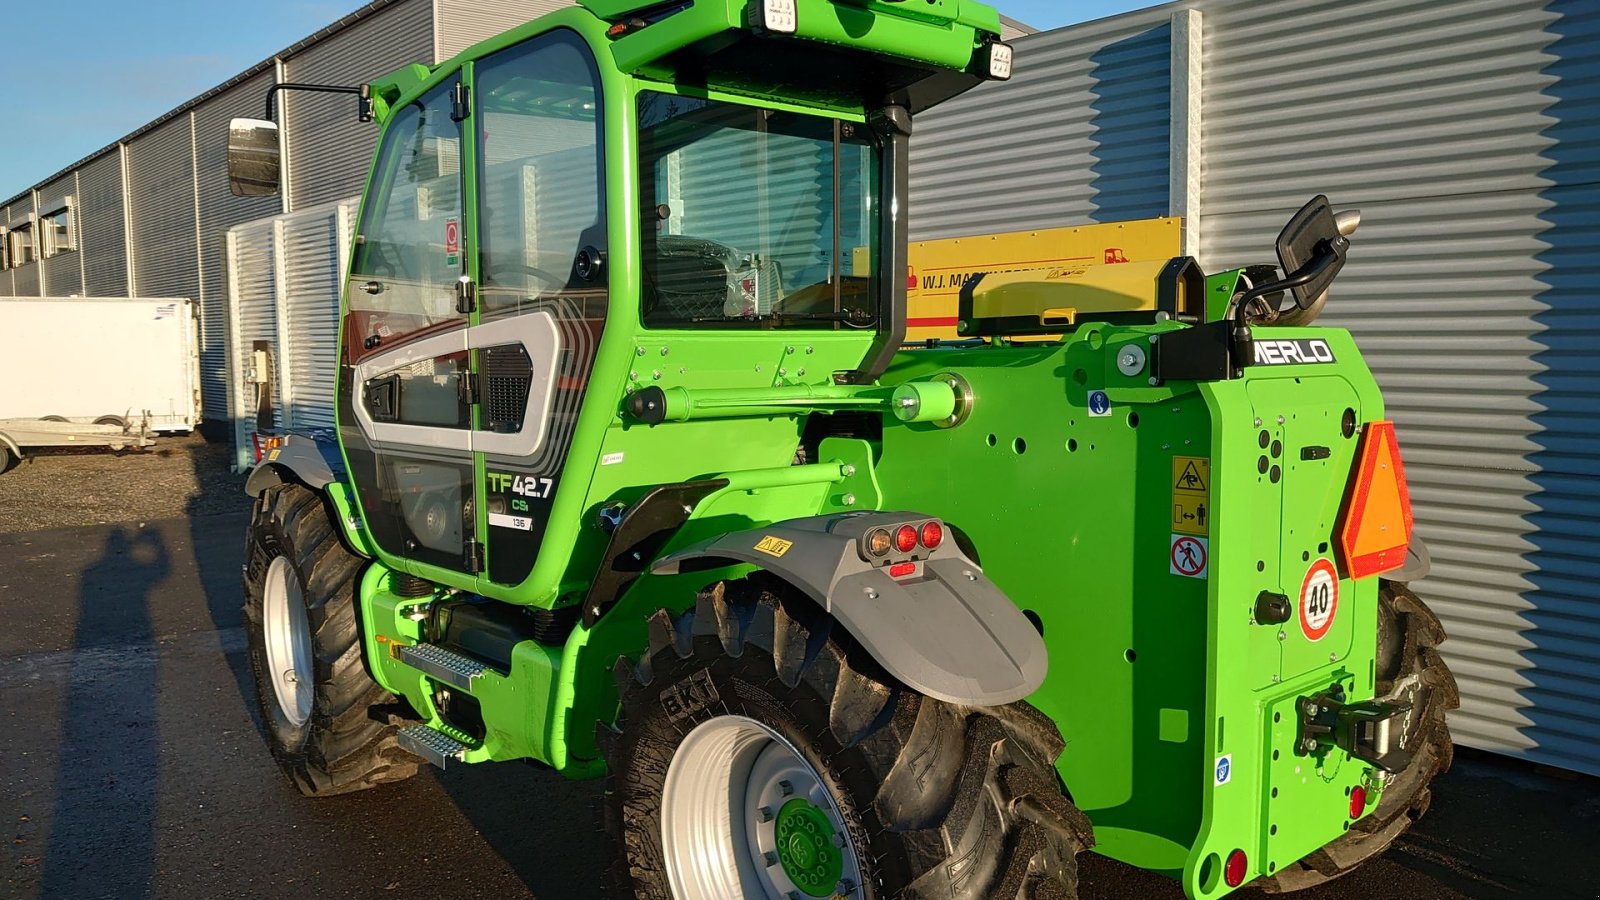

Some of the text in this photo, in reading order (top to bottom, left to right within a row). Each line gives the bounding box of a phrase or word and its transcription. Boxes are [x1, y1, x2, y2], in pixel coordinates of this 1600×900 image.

[923, 275, 946, 289] W.J.
[513, 518, 526, 528] 136
[1309, 582, 1329, 616] 40
[661, 671, 718, 717] BKT
